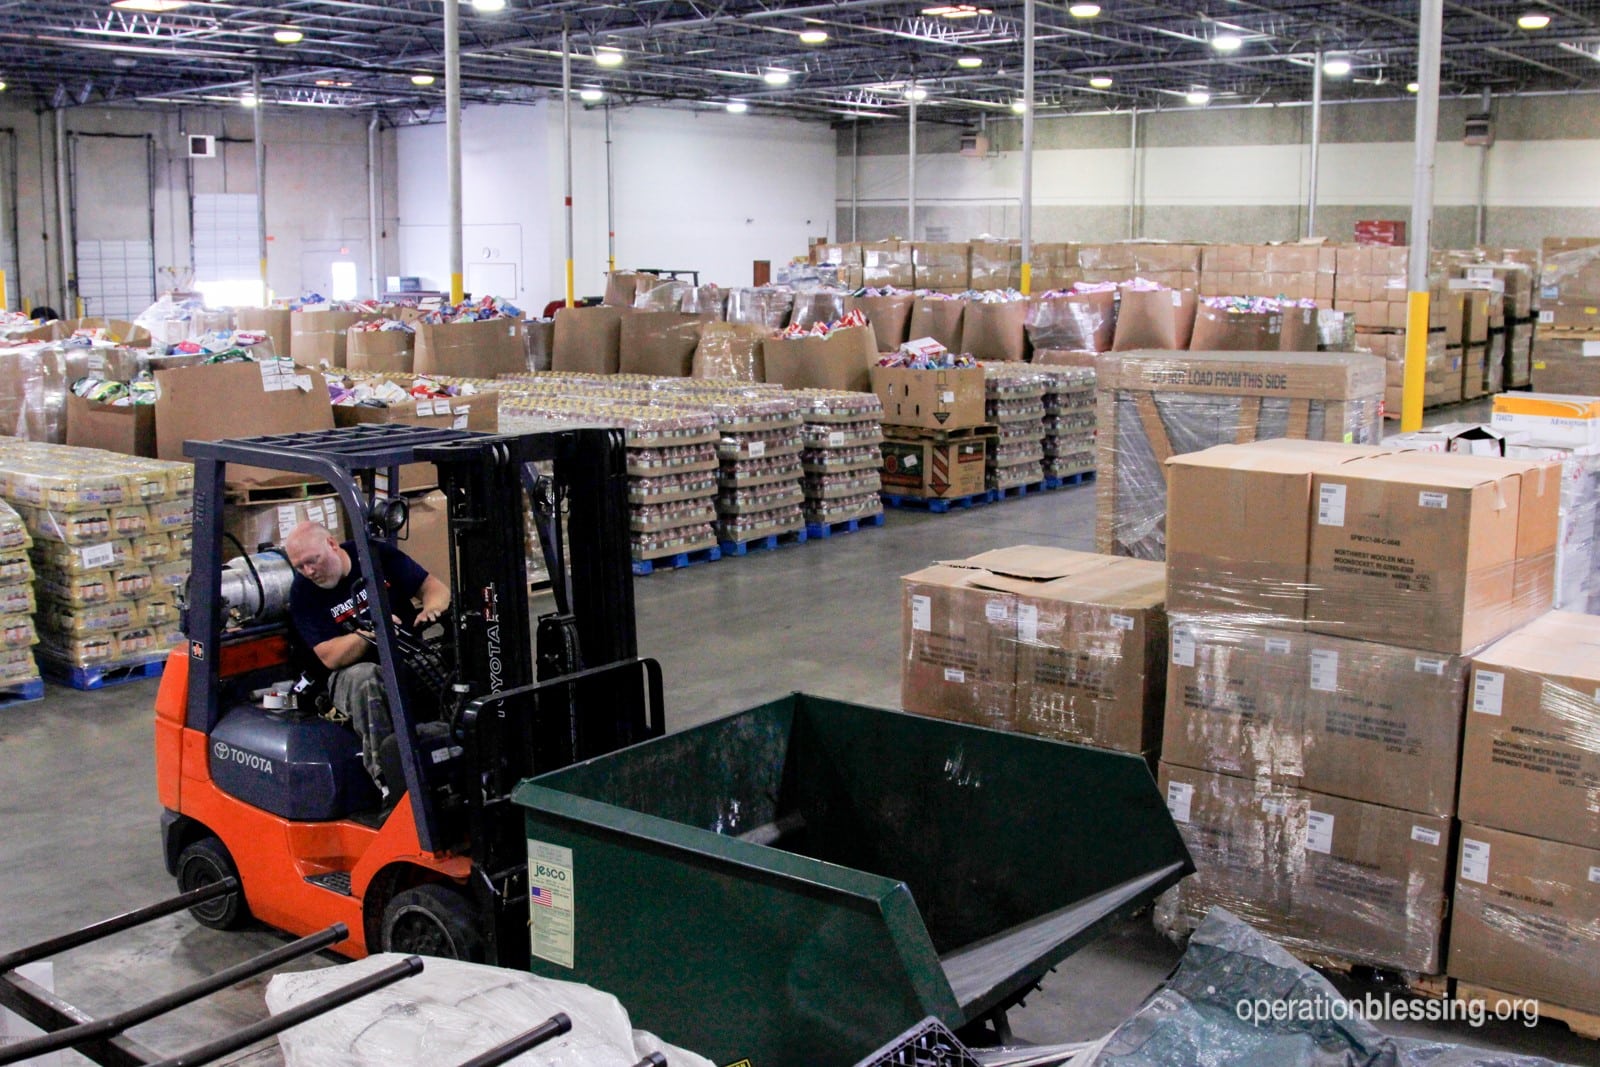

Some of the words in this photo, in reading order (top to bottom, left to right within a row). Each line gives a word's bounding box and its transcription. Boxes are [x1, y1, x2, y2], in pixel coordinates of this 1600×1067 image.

[1188, 370, 1213, 386] LOAD
[1214, 371, 1241, 388] FROM
[1242, 372, 1263, 388] THIS
[1265, 373, 1287, 389] SIDE
[1334, 549, 1369, 558] NORTHWEST
[1397, 557, 1414, 565] MILLS
[231, 748, 272, 774] TOYOTA
[534, 864, 566, 881] jesco
